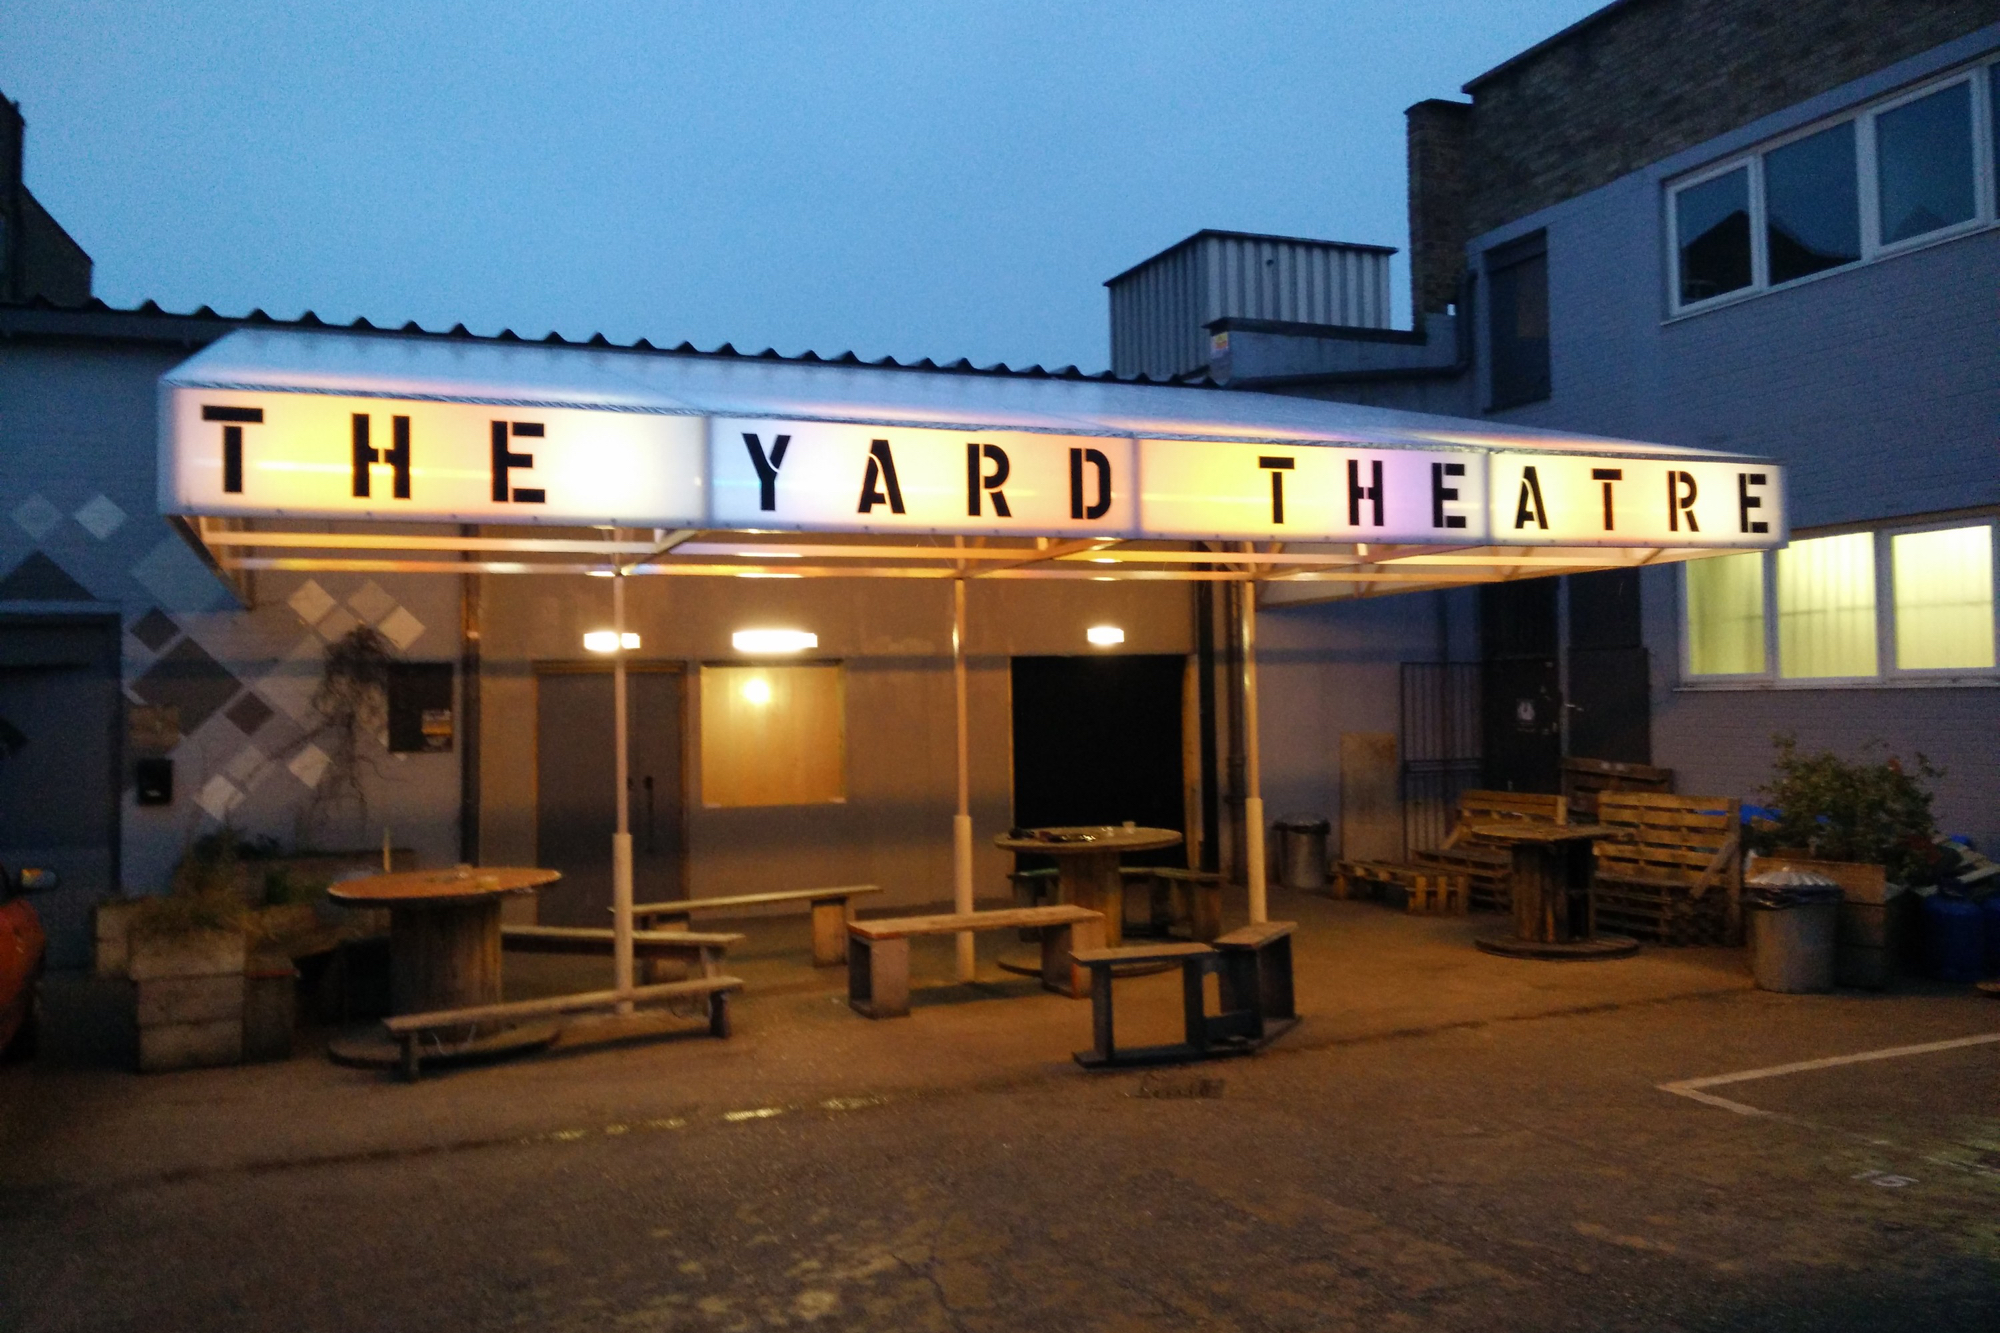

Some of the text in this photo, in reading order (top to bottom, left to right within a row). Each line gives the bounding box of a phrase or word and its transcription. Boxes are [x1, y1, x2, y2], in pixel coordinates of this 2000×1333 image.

[201, 404, 1769, 534] THE YARD THEATRE
